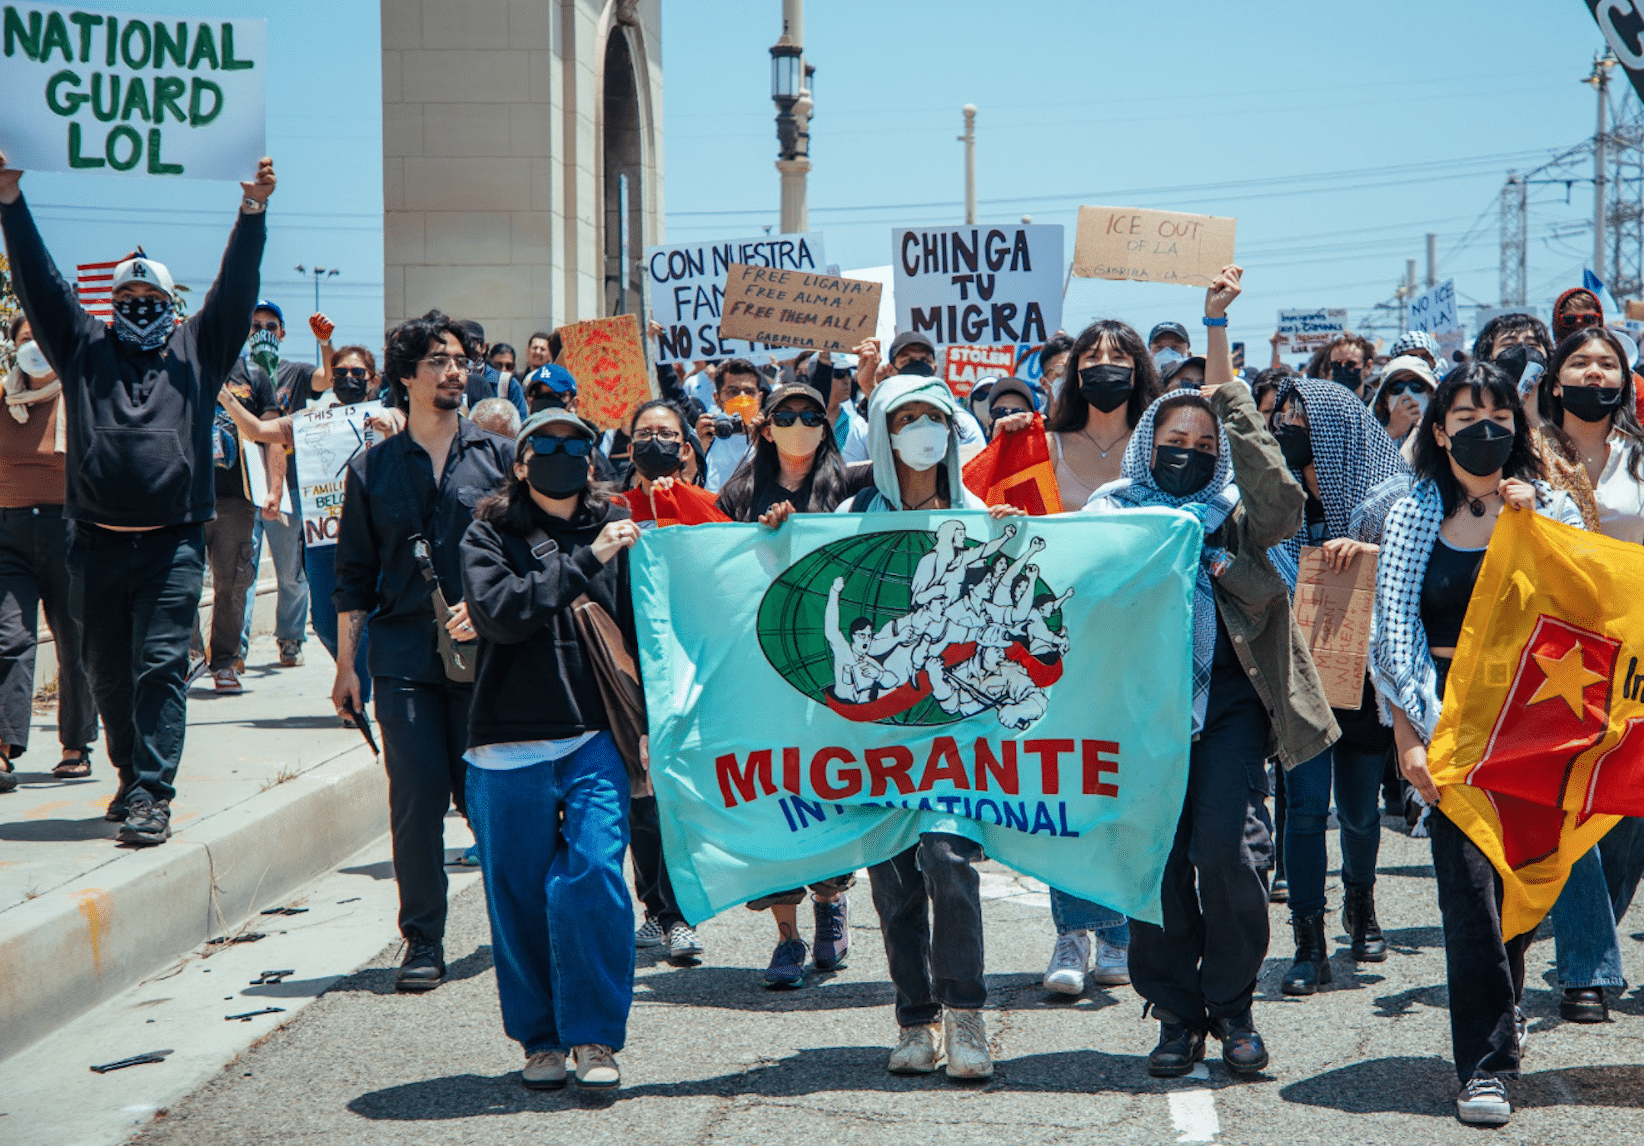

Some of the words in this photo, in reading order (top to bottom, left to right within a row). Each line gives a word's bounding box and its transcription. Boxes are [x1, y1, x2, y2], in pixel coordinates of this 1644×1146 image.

[3, 6, 254, 71] NATIONAL
[45, 70, 224, 127] GUARD
[68, 122, 184, 175] LOL
[1106, 214, 1142, 235] ICE
[1158, 220, 1204, 240] OUT
[650, 247, 704, 283] CON
[712, 237, 816, 277] NUESTRA
[901, 229, 1031, 277] CHINGA
[1127, 240, 1147, 252] OF
[1153, 242, 1178, 257] LA
[741, 267, 791, 285] FREE
[803, 275, 873, 295] LIGAYA!
[744, 284, 787, 301] FREE
[793, 291, 853, 309] ALMA!
[951, 273, 995, 301] TU
[729, 300, 775, 318] FREE
[779, 308, 818, 325] THEM
[1412, 296, 1429, 316] NO
[1434, 281, 1455, 304] ICE
[911, 302, 1047, 343] MIGRA
[657, 325, 692, 361] NO
[756, 331, 814, 347] GABRIELA
[950, 347, 1010, 366] STOLEN
[948, 363, 1009, 382] LAND
[304, 409, 334, 422] THIS
[345, 405, 356, 416] IS
[302, 480, 343, 497] FAMILI
[1623, 657, 1644, 704] In
[715, 736, 1120, 809] MIGRANTE
[778, 795, 1080, 838] INTIONAL
